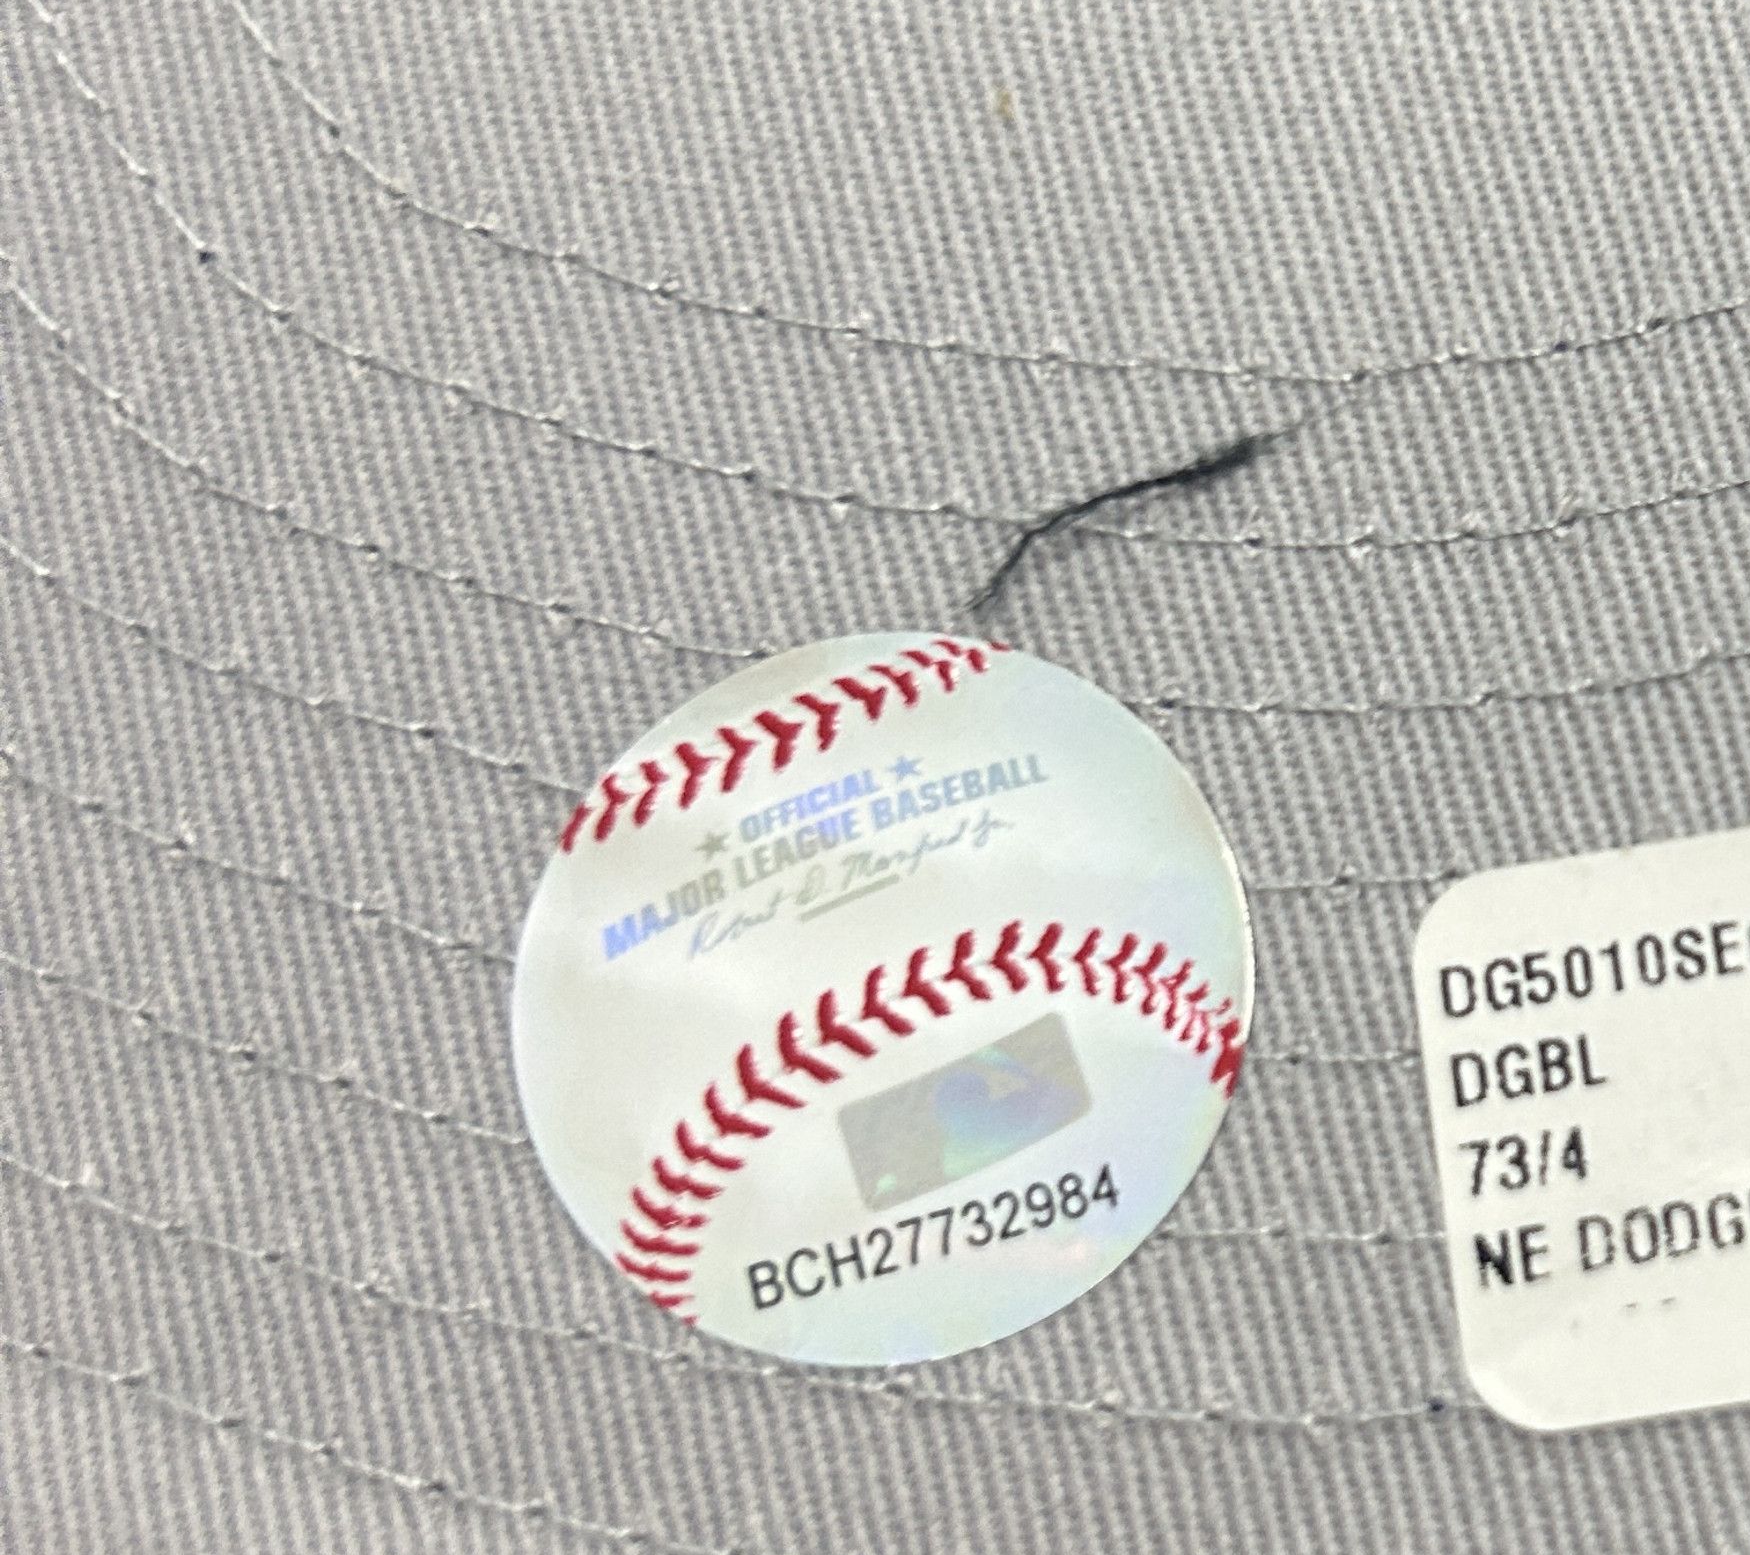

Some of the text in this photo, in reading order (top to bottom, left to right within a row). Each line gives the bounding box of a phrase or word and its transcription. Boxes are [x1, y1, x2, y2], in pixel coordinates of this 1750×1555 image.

[739, 768, 881, 843] OFFICIAL
[601, 754, 1050, 961] MAJOR LEAGUE BASEBALL
[1450, 1034, 1610, 1108] DGBL
[1458, 1124, 1590, 1198] 73/4
[745, 1162, 1121, 1312] BCH27732984
[1473, 1223, 1552, 1290] NE
